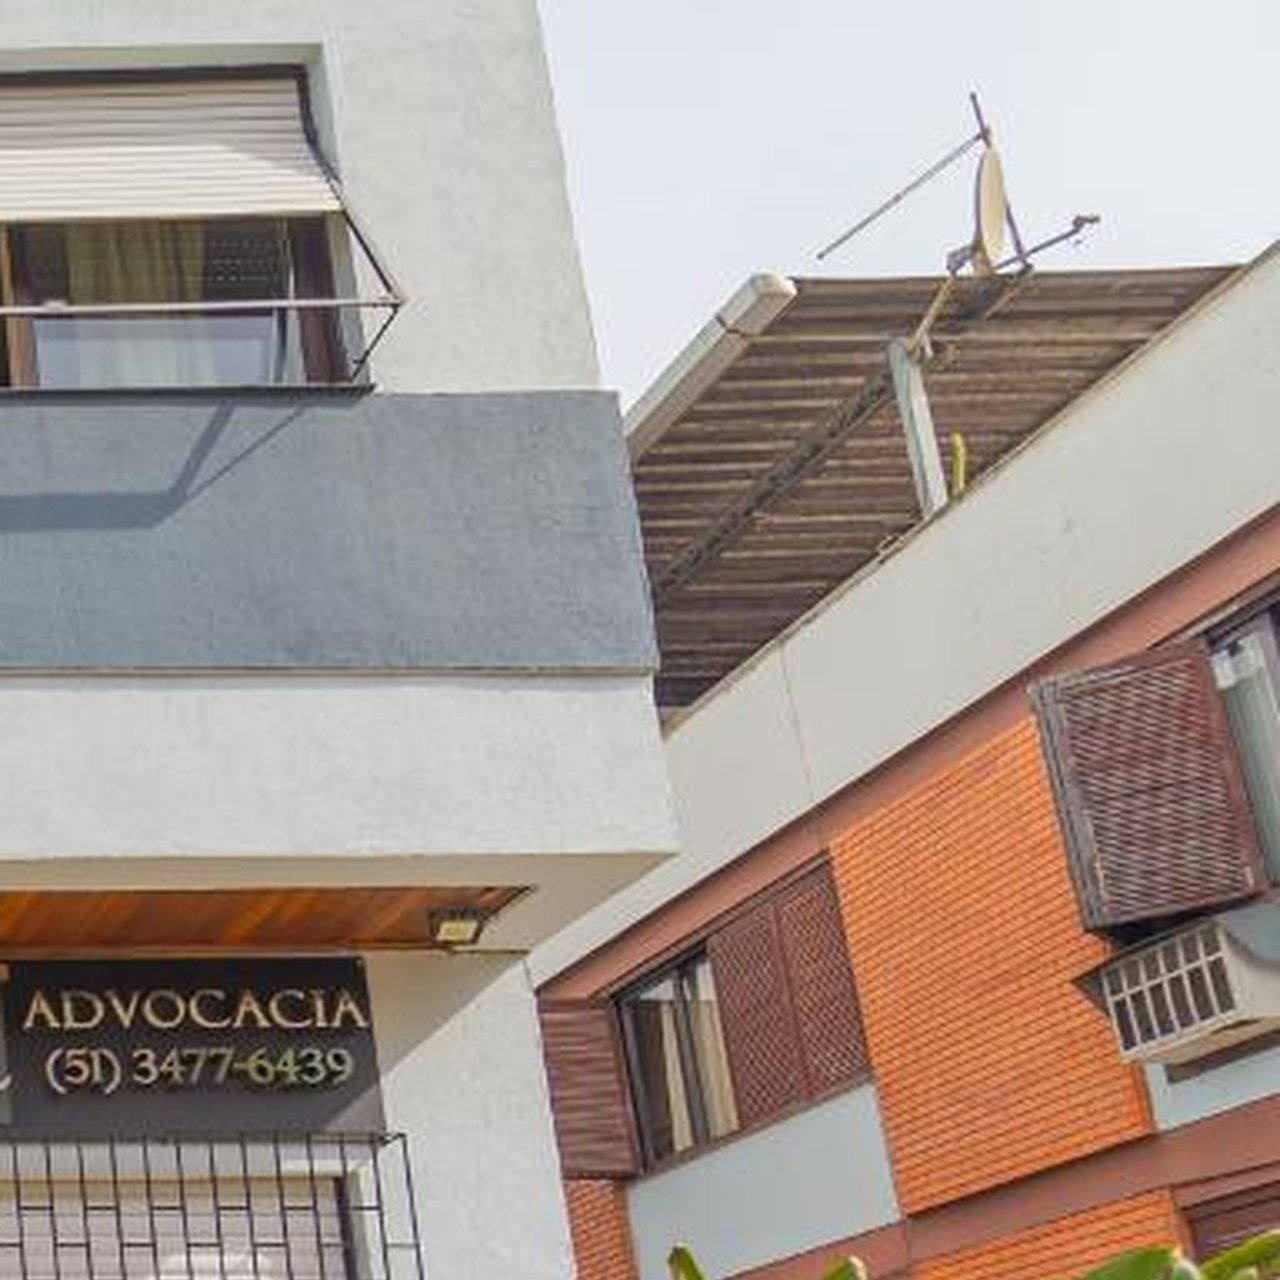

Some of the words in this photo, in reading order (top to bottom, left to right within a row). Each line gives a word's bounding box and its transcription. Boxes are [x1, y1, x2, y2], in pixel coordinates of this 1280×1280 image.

[23, 988, 370, 1030] ADVOCACIA
[45, 1049, 122, 1095] (51)
[132, 1048, 354, 1085] 3477-6439
